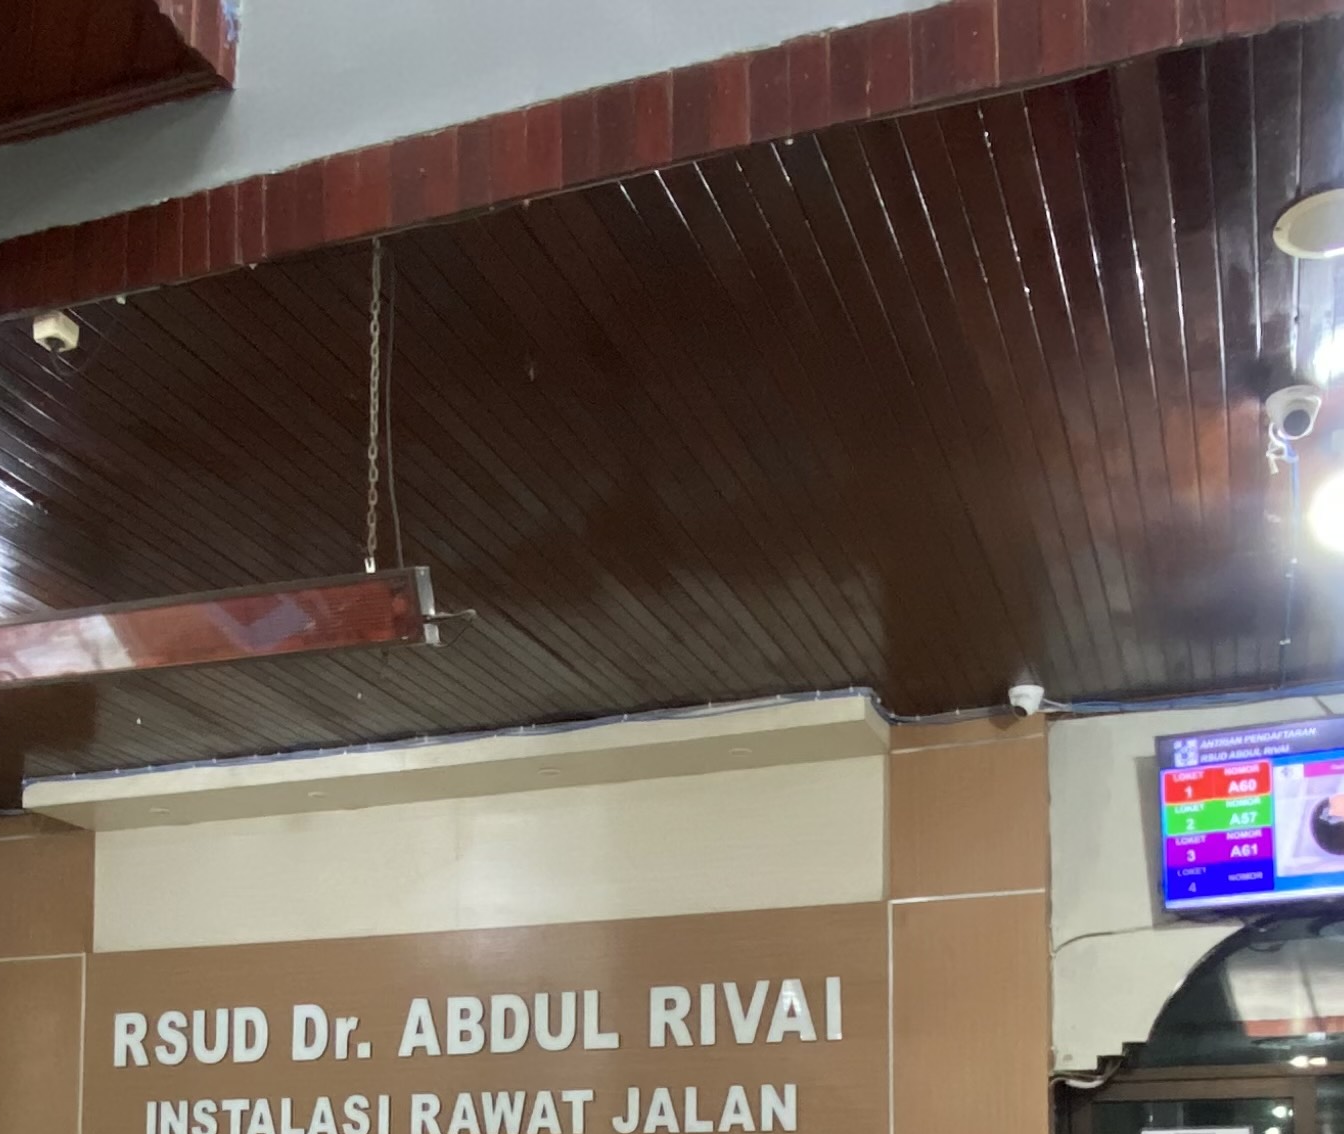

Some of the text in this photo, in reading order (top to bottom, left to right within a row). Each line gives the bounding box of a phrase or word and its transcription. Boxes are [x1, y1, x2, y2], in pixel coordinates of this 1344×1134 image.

[1199, 727, 1317, 750] ANTRIAN PENDAFTARAN
[1199, 751, 1228, 764] RSUD
[1228, 747, 1263, 760] ABDUL
[1184, 786, 1193, 799] 1
[1228, 778, 1258, 794] A60
[1186, 818, 1196, 831] 2
[1229, 811, 1259, 826] A57
[1186, 849, 1197, 863] 3
[1230, 843, 1259, 858] A61
[1188, 882, 1197, 893] 4
[112, 976, 844, 1069] RSUD Dr. ABDUL RIVAI
[610, 1083, 798, 1134] JALAN
